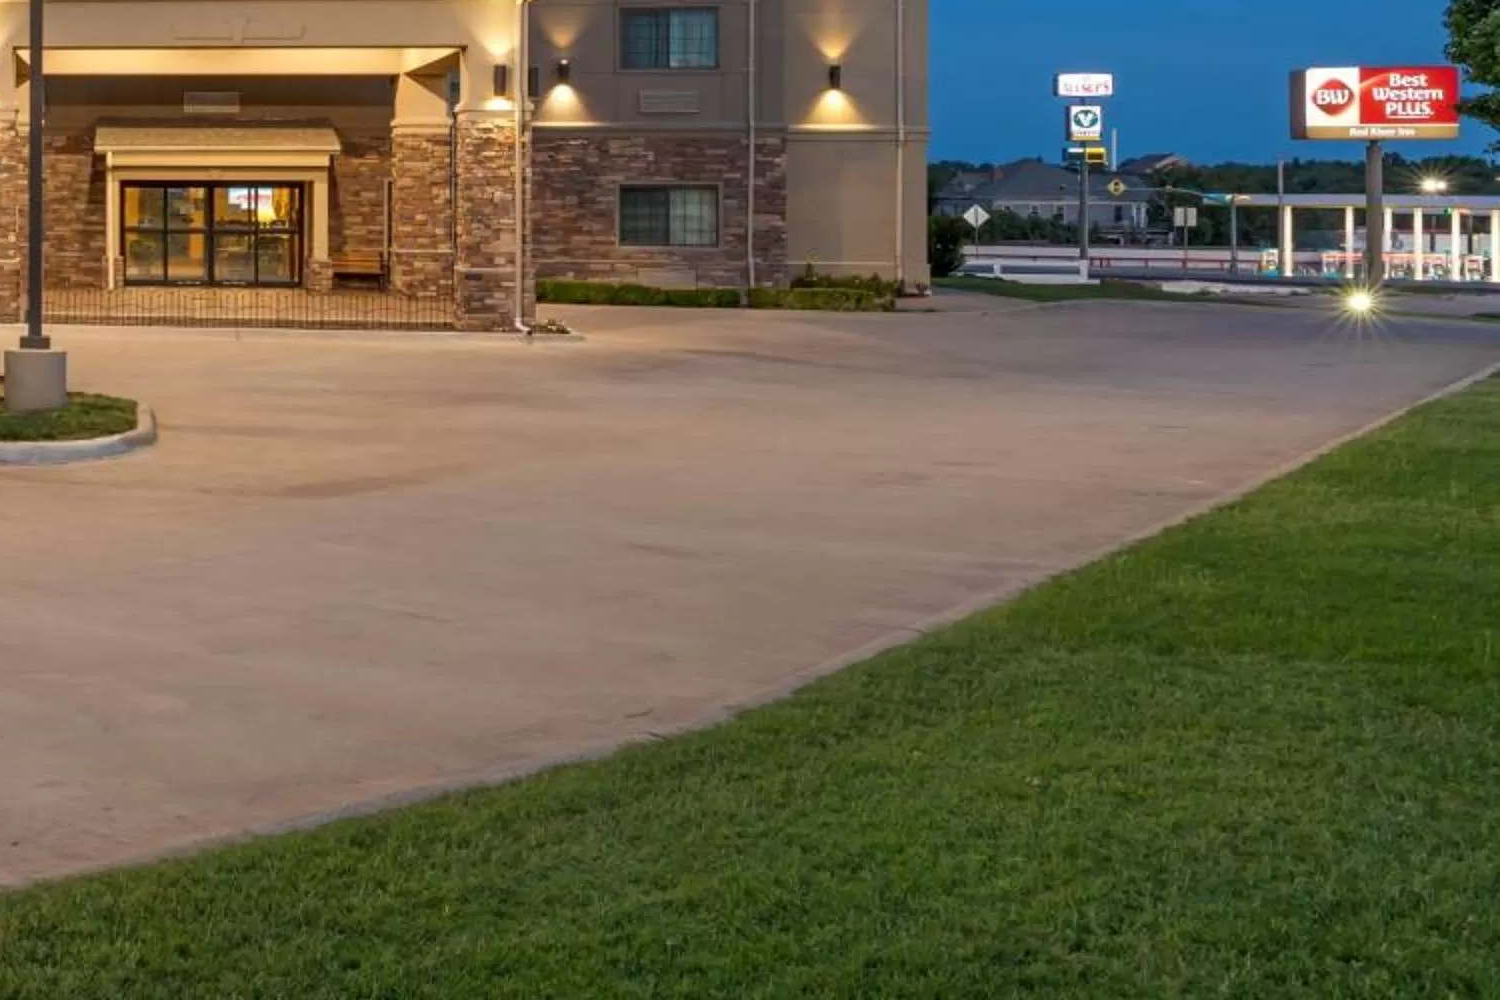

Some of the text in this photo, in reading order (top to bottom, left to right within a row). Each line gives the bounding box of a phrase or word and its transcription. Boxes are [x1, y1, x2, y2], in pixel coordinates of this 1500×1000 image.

[1389, 73, 1428, 87] Best
[1316, 89, 1349, 105] BW
[1372, 87, 1443, 100] Western
